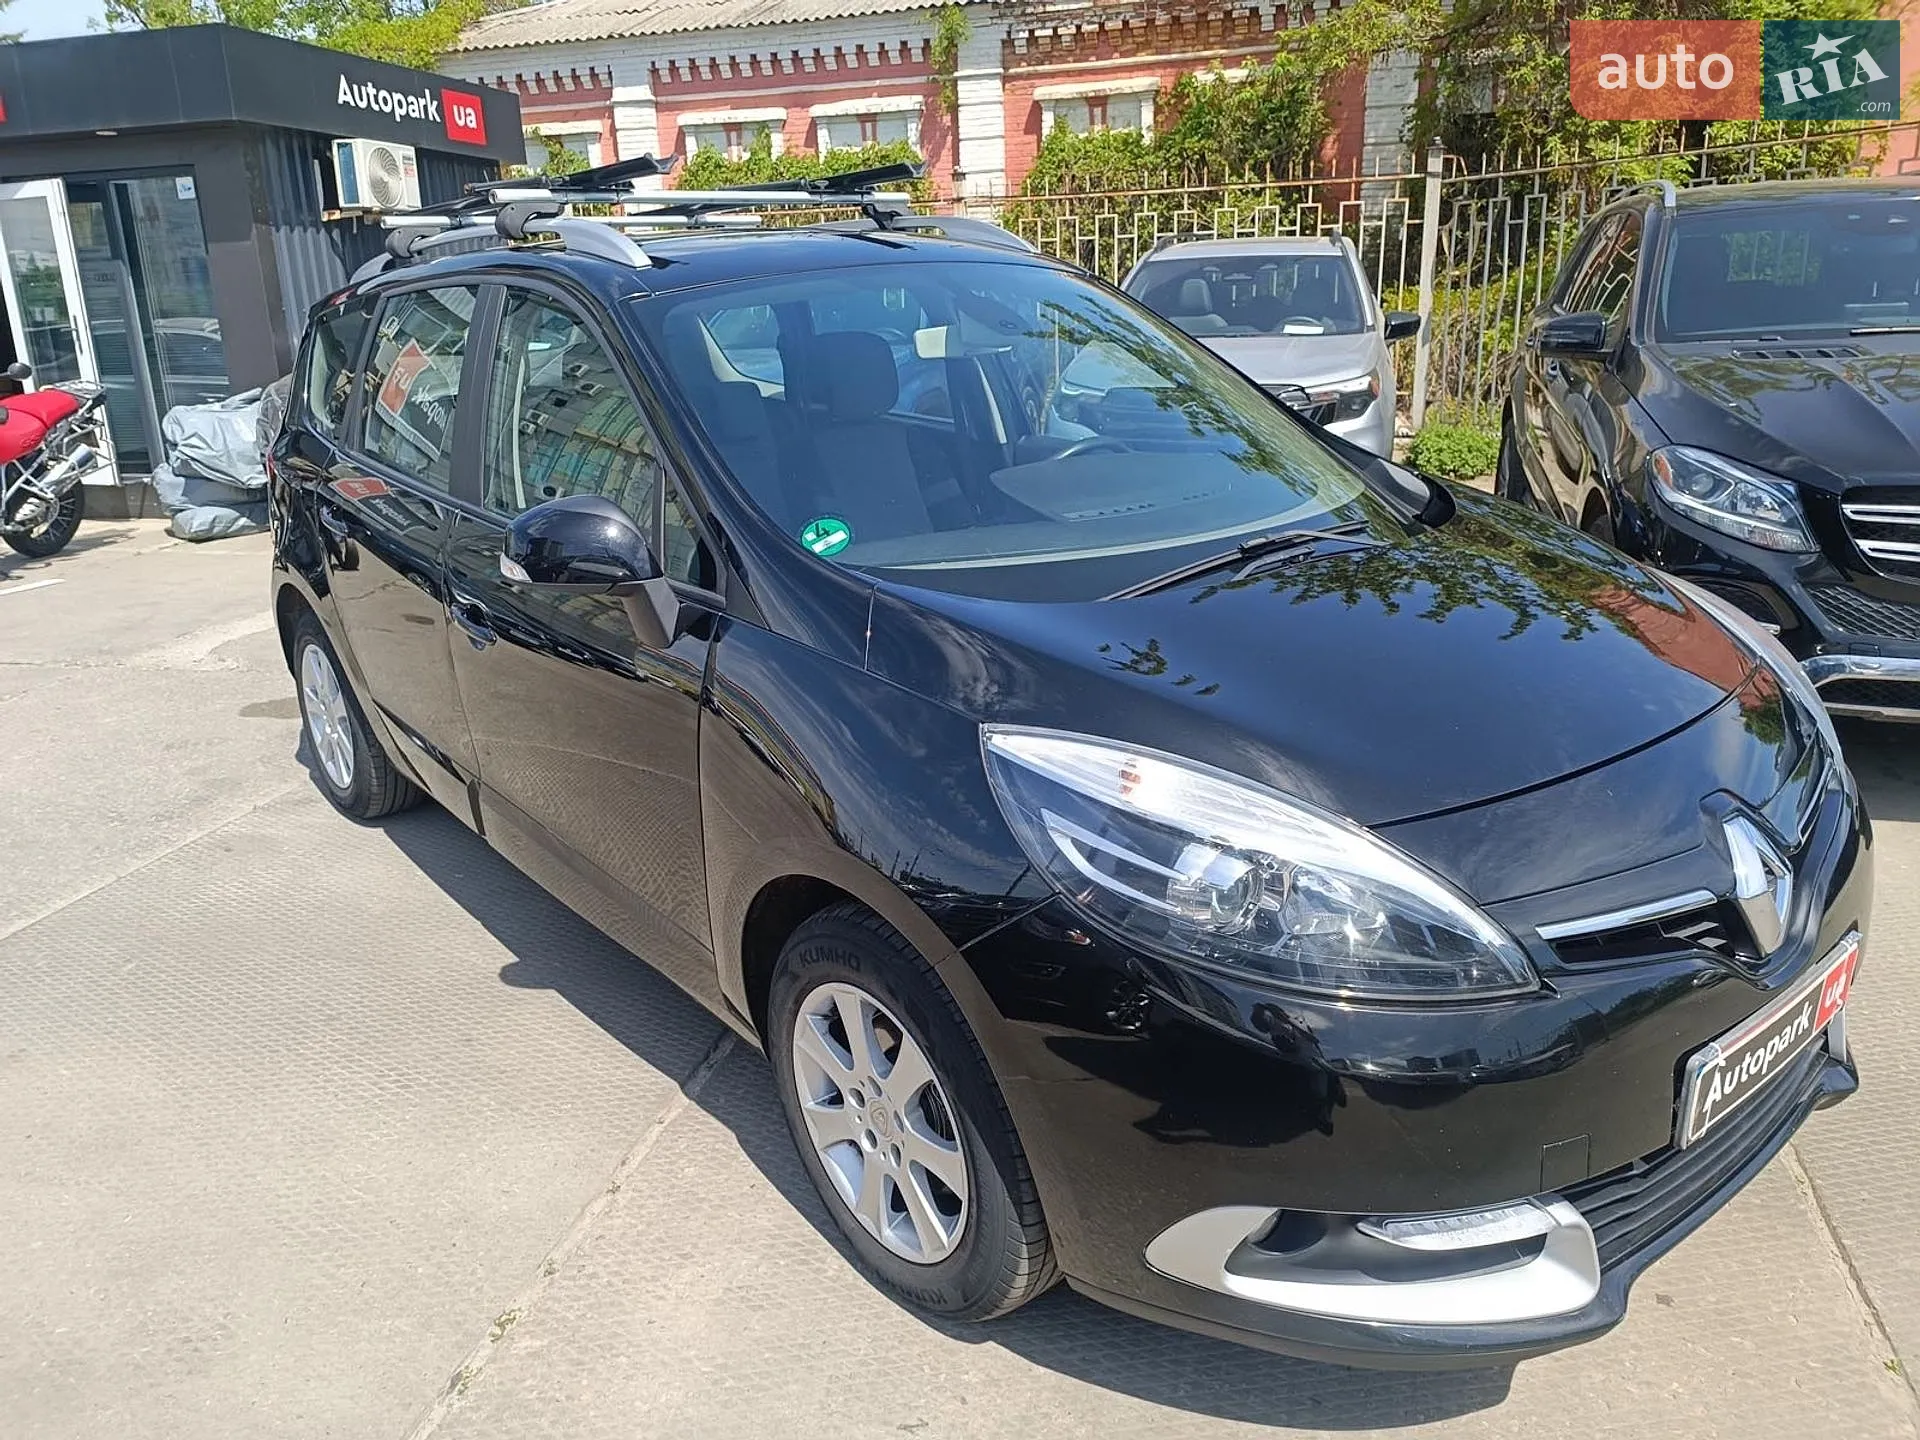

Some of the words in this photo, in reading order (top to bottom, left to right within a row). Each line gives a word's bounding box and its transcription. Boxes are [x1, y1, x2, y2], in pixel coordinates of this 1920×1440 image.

[337, 73, 441, 123] Autopark
[453, 104, 477, 129] ua
[799, 945, 861, 972] KUMHO
[1703, 1001, 1813, 1113] Autopark
